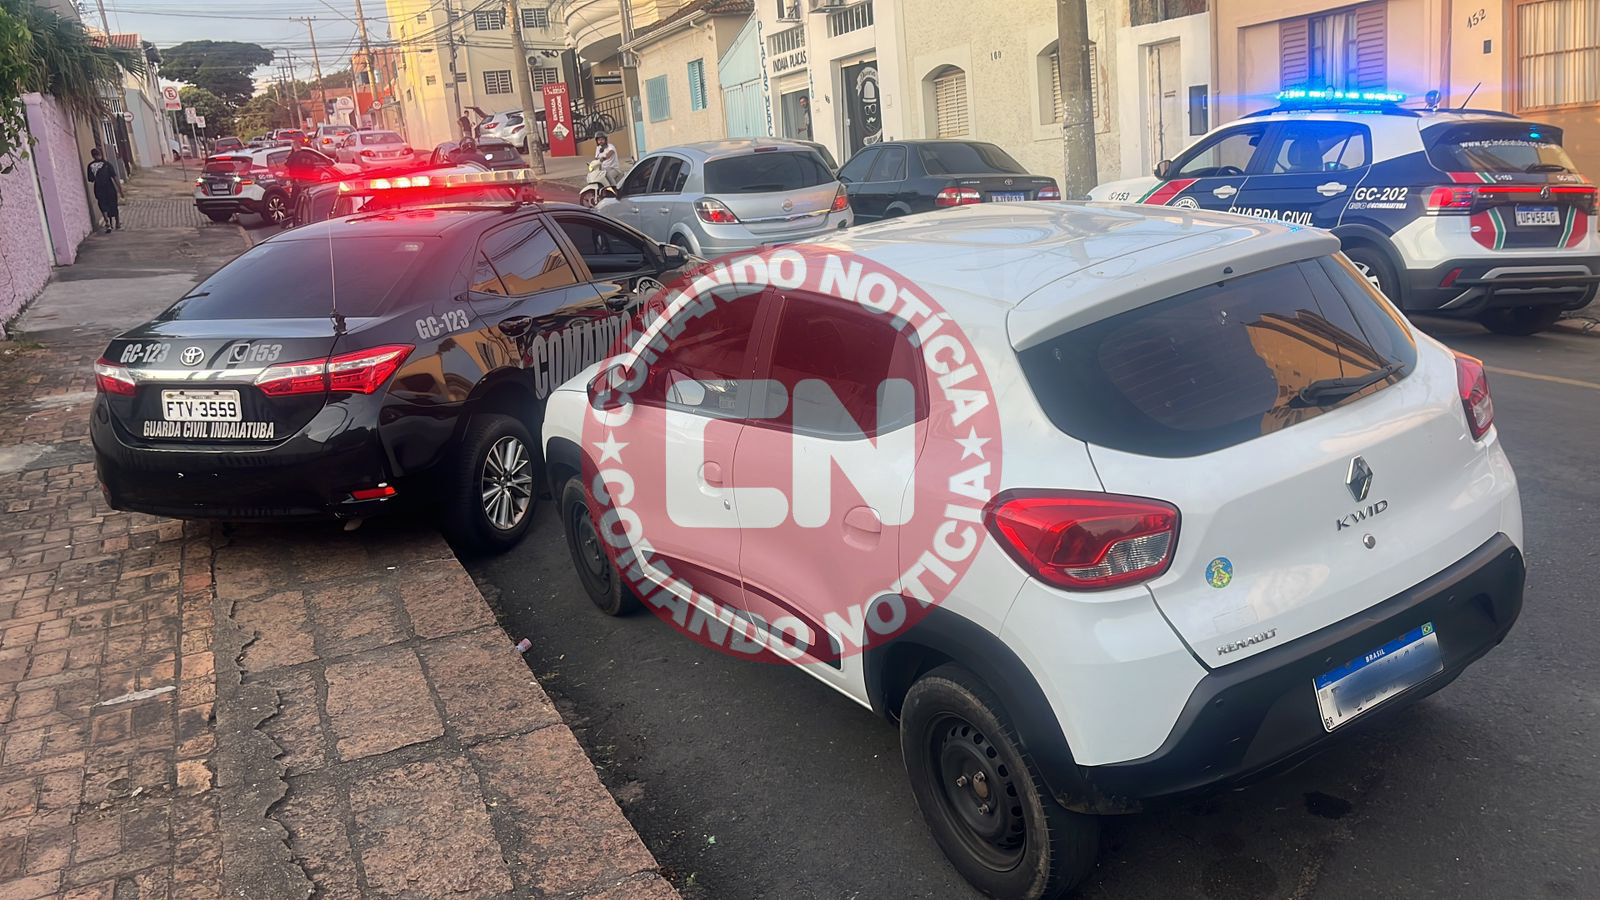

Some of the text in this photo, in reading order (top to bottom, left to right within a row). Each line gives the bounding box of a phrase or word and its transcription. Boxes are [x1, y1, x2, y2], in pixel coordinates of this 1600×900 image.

[1467, 8, 1487, 29] 152
[757, 20, 769, 92] PLACAS
[789, 50, 807, 68] PLACAS
[1115, 191, 1130, 201] 153
[1355, 187, 1409, 201] GC-202
[1281, 208, 1314, 226] CIVIL
[416, 309, 470, 340] GC-123
[120, 342, 171, 364] GC-123
[249, 344, 282, 361] 153
[532, 311, 633, 400] COMANDO
[143, 420, 275, 438] GUARDA CIVIL INDAIATUBA
[1336, 499, 1389, 531] KWID
[1216, 627, 1278, 656] RENAULT
[1365, 648, 1386, 663] BRASIL
